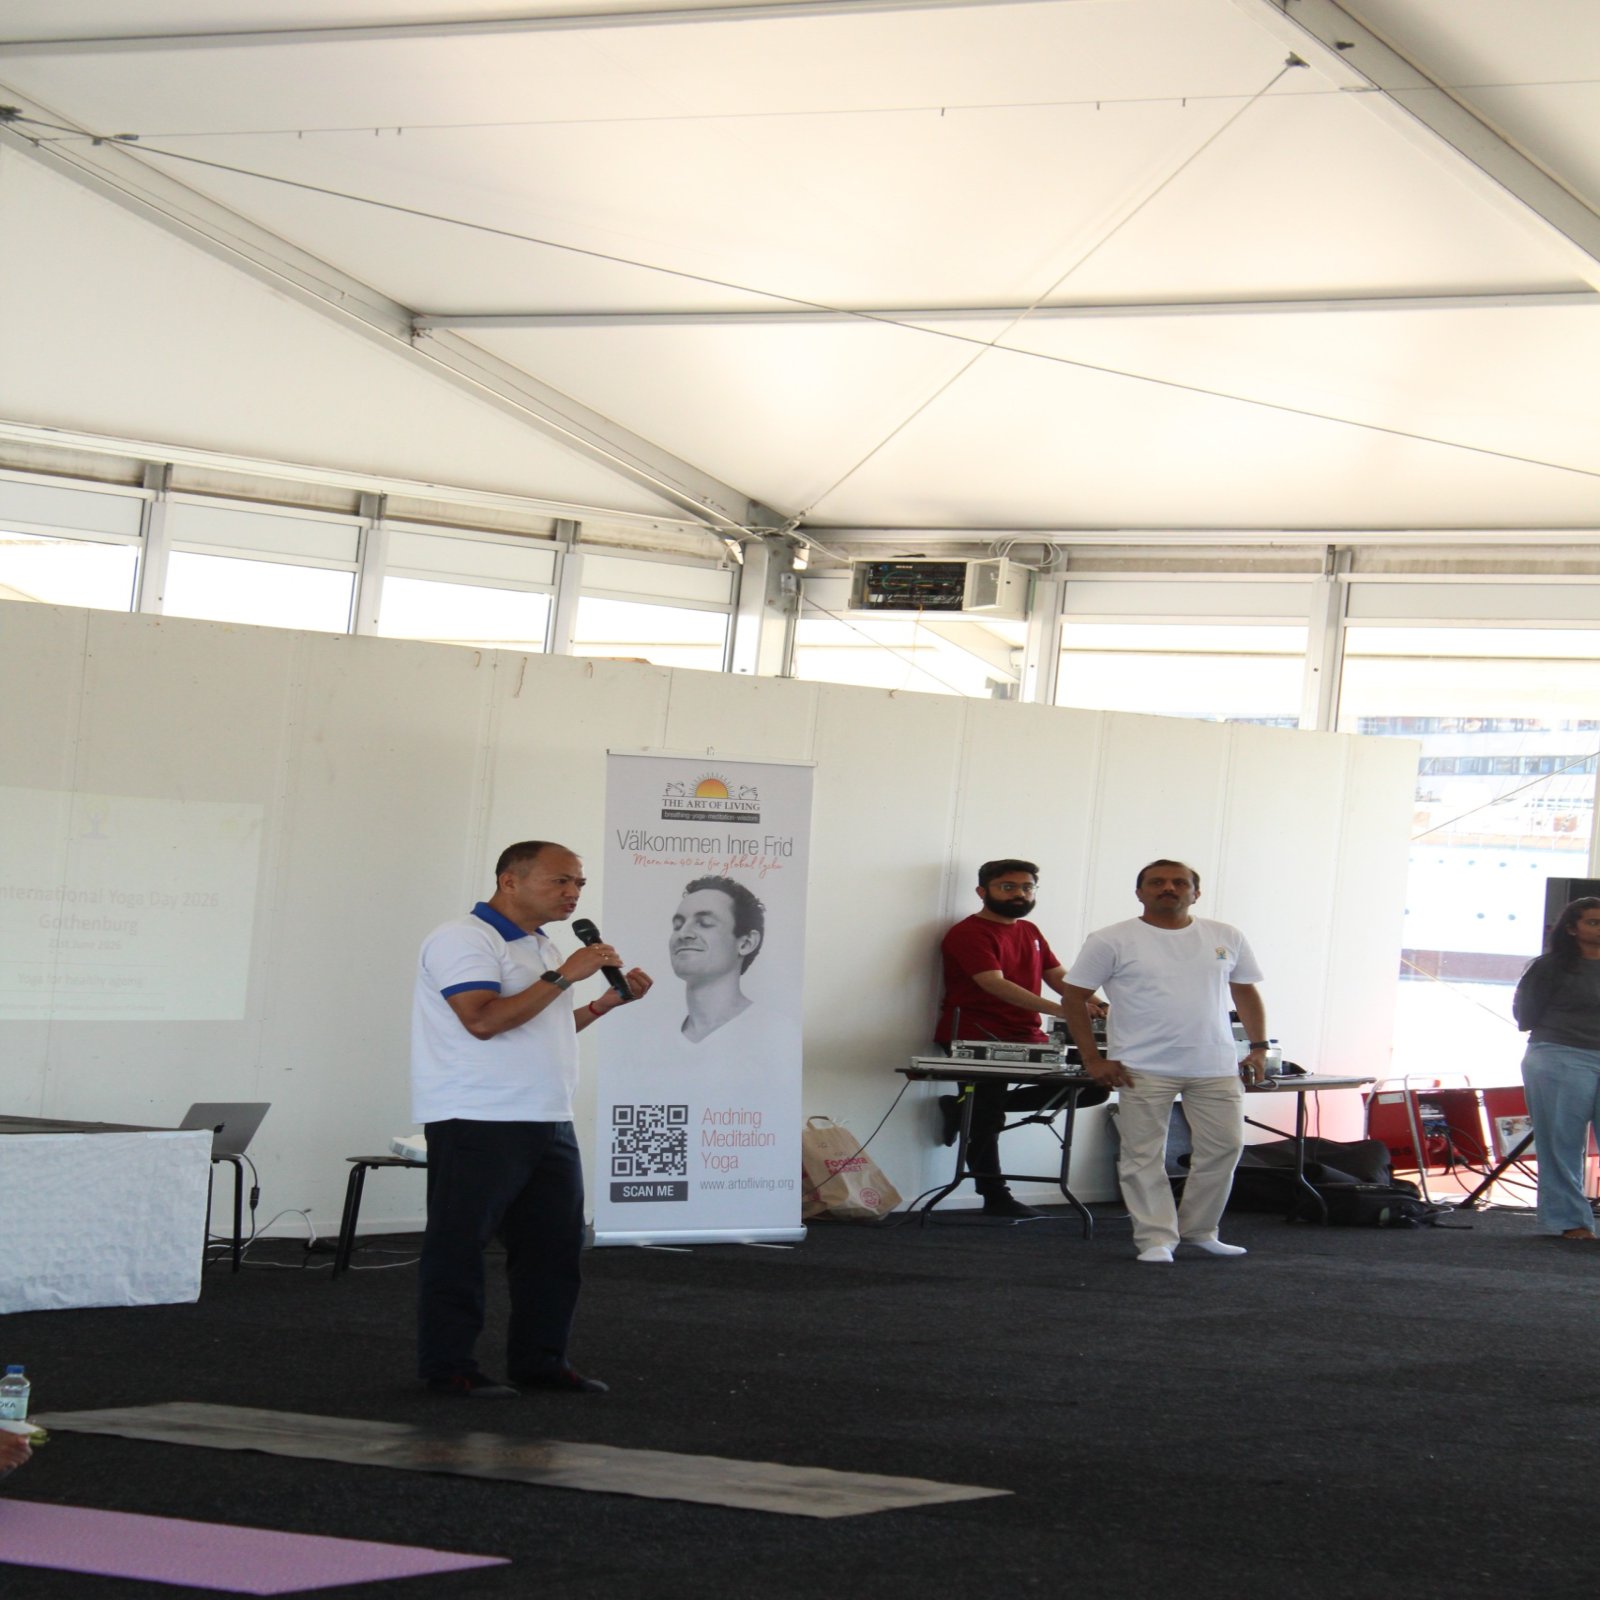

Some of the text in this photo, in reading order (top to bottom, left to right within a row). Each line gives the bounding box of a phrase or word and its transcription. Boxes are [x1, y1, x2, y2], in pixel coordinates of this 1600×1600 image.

[662, 798, 760, 811] THE ART OF LIVING
[616, 829, 793, 857] Välkommen Inre Frid
[109, 889, 144, 909] Yoga
[150, 891, 178, 910] Day
[38, 913, 139, 936] Gothenburg
[701, 1107, 762, 1129] Andning
[701, 1129, 775, 1148] Meditation
[701, 1151, 739, 1173] Yoga
[623, 1185, 674, 1197] SCAN ME
[700, 1177, 794, 1191] www.artofliving.org
